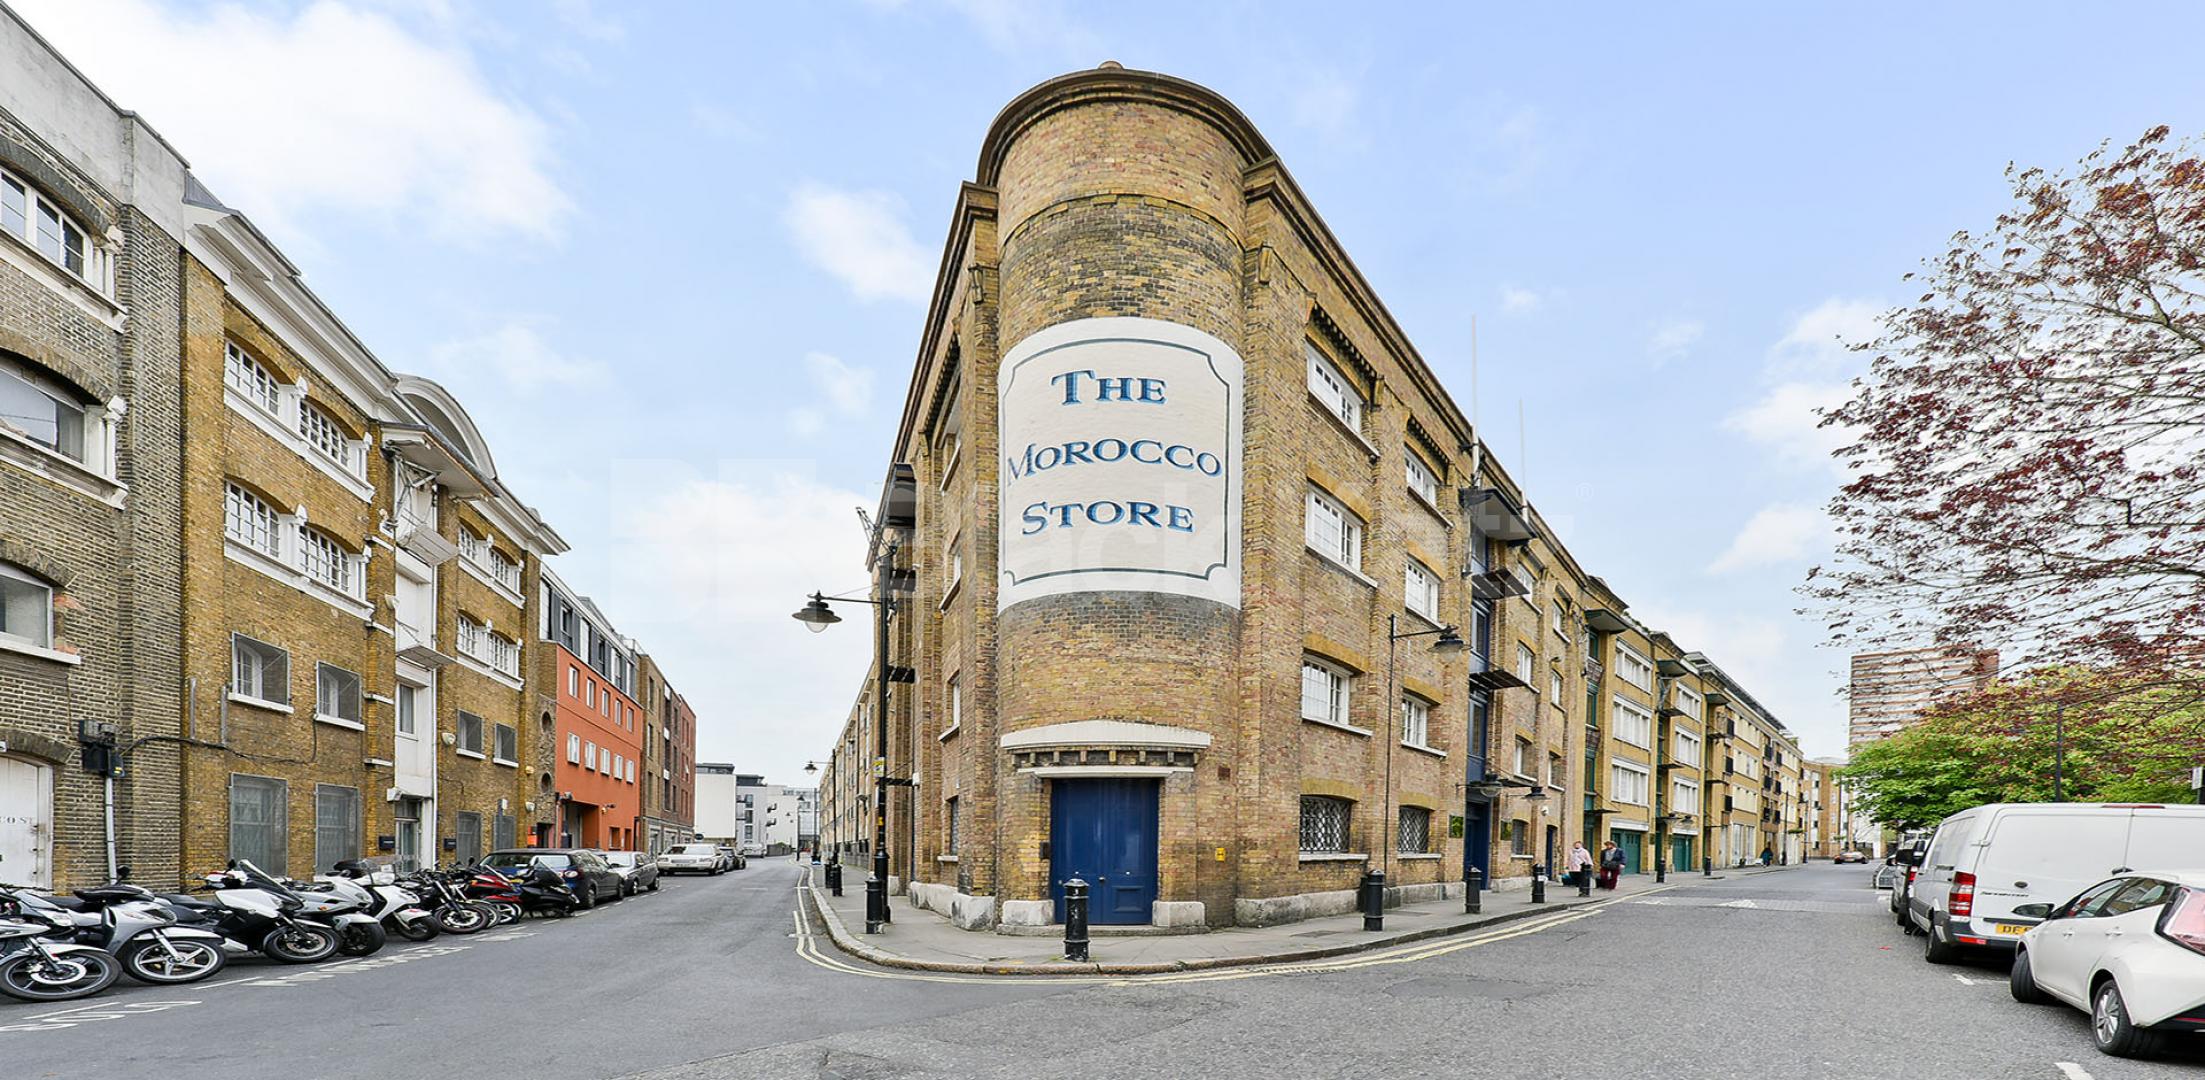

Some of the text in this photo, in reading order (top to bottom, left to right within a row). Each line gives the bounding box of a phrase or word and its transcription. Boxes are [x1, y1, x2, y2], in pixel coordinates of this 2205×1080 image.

[1051, 370, 1168, 405] THE
[1008, 438, 1222, 486] MOROCCO
[1022, 500, 1194, 535] STORE
